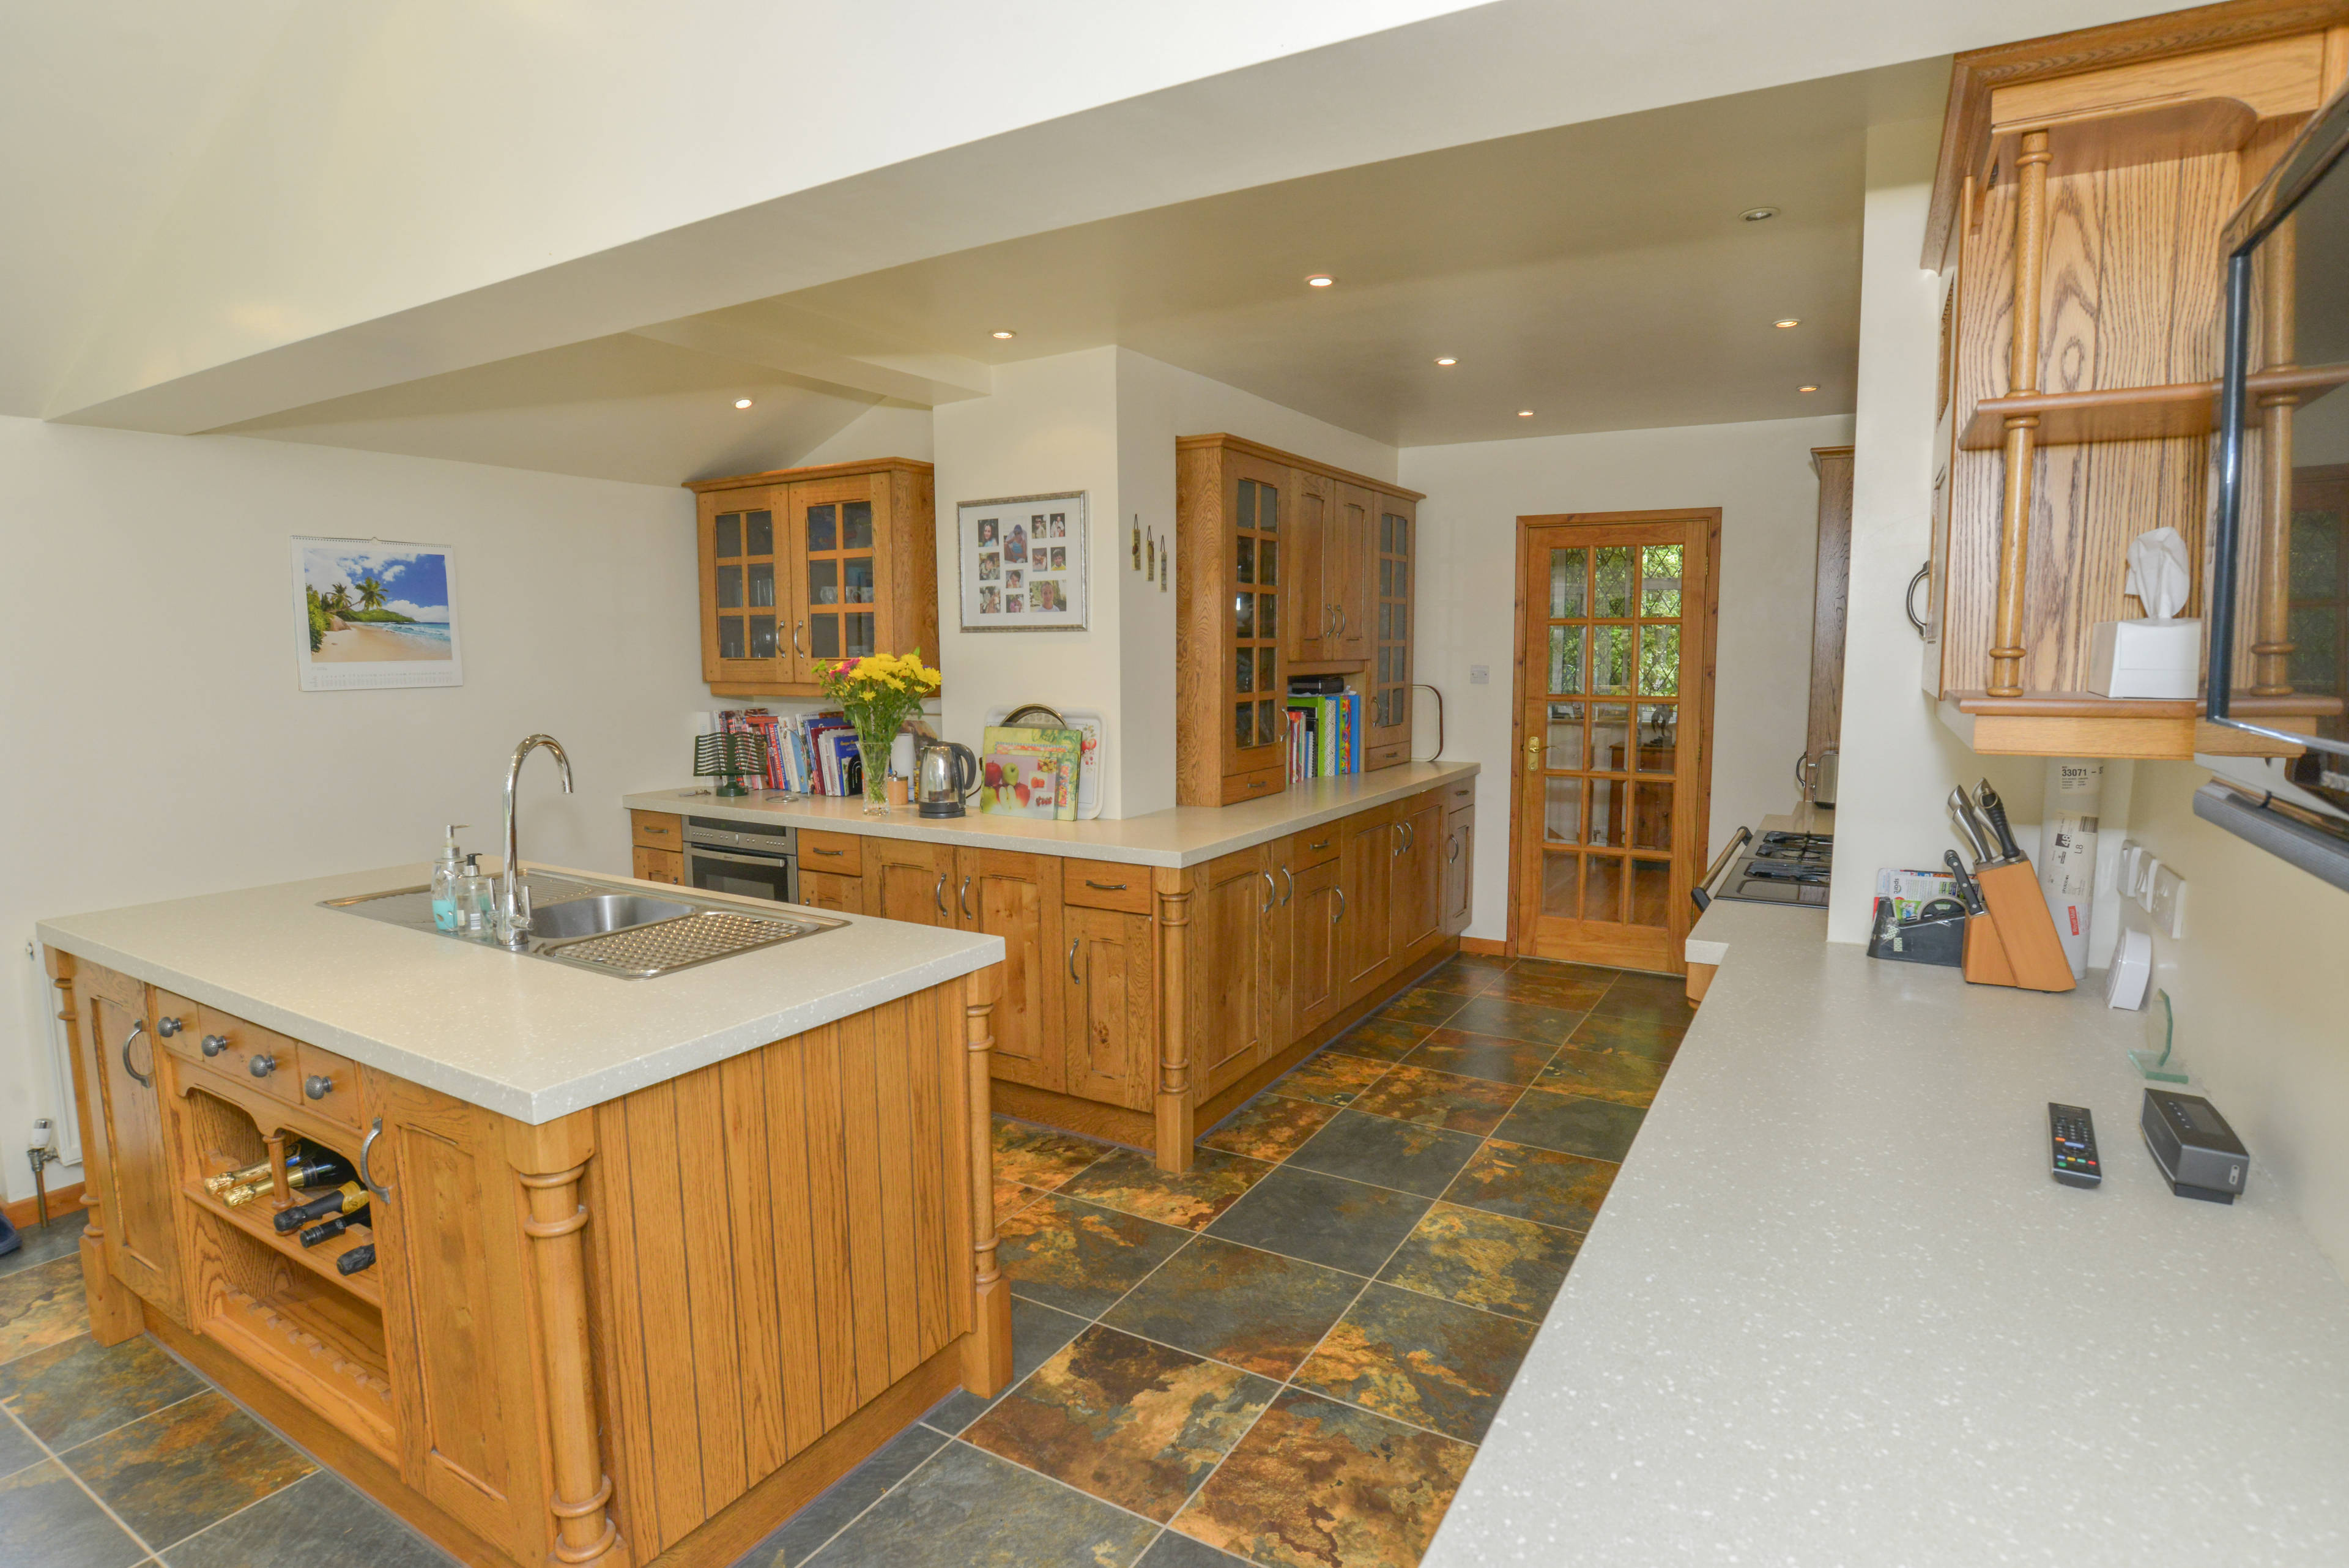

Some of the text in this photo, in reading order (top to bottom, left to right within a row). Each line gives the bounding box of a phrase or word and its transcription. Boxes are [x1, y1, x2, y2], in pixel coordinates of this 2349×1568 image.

[2061, 768, 2087, 777] 33071
[2061, 834, 2071, 847] 48
[2074, 844, 2084, 854] L8
